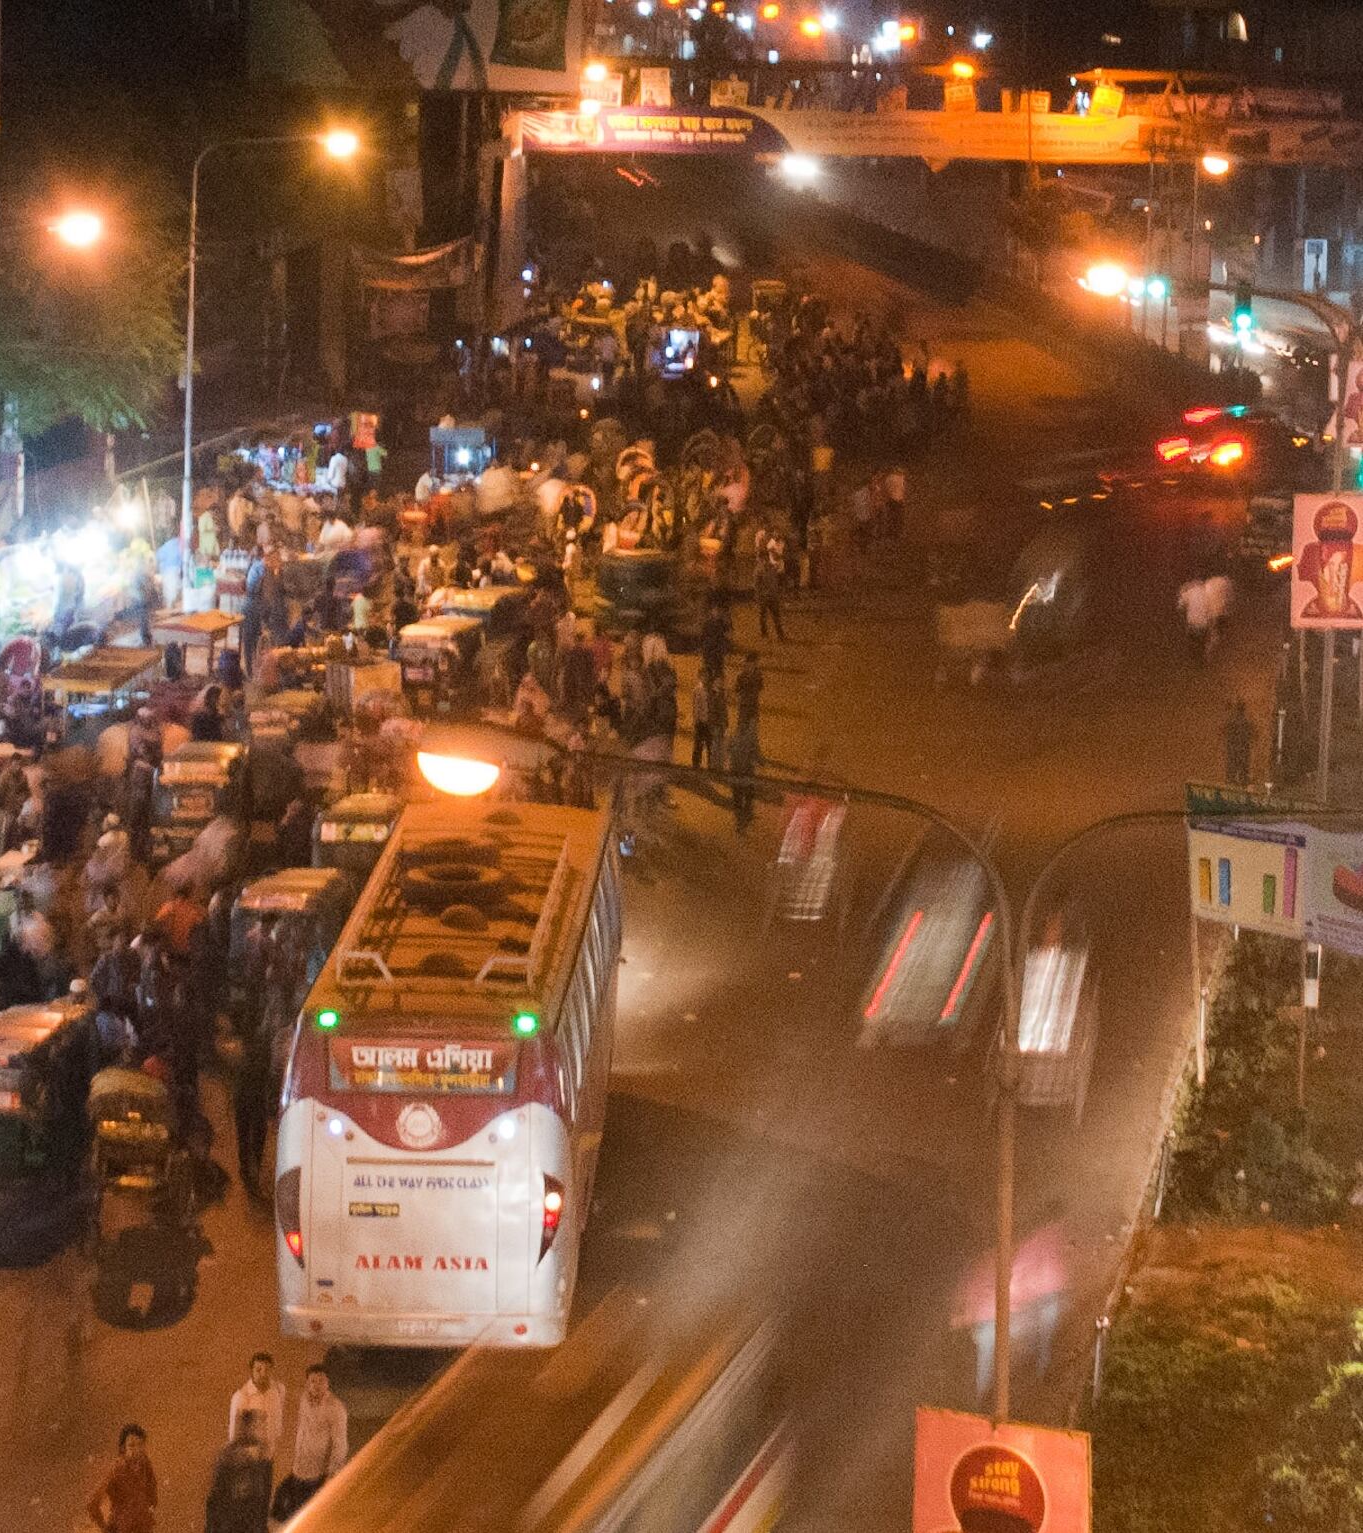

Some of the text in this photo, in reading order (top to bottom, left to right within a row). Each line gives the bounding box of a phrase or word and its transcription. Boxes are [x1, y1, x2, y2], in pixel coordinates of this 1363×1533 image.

[352, 1046, 420, 1069] আলম
[353, 1174, 373, 1188] ALL
[398, 1175, 424, 1189] WAY
[355, 1254, 489, 1271] ALAM ASIA
[984, 1461, 1020, 1478] stay
[970, 1475, 1020, 1496] strong
